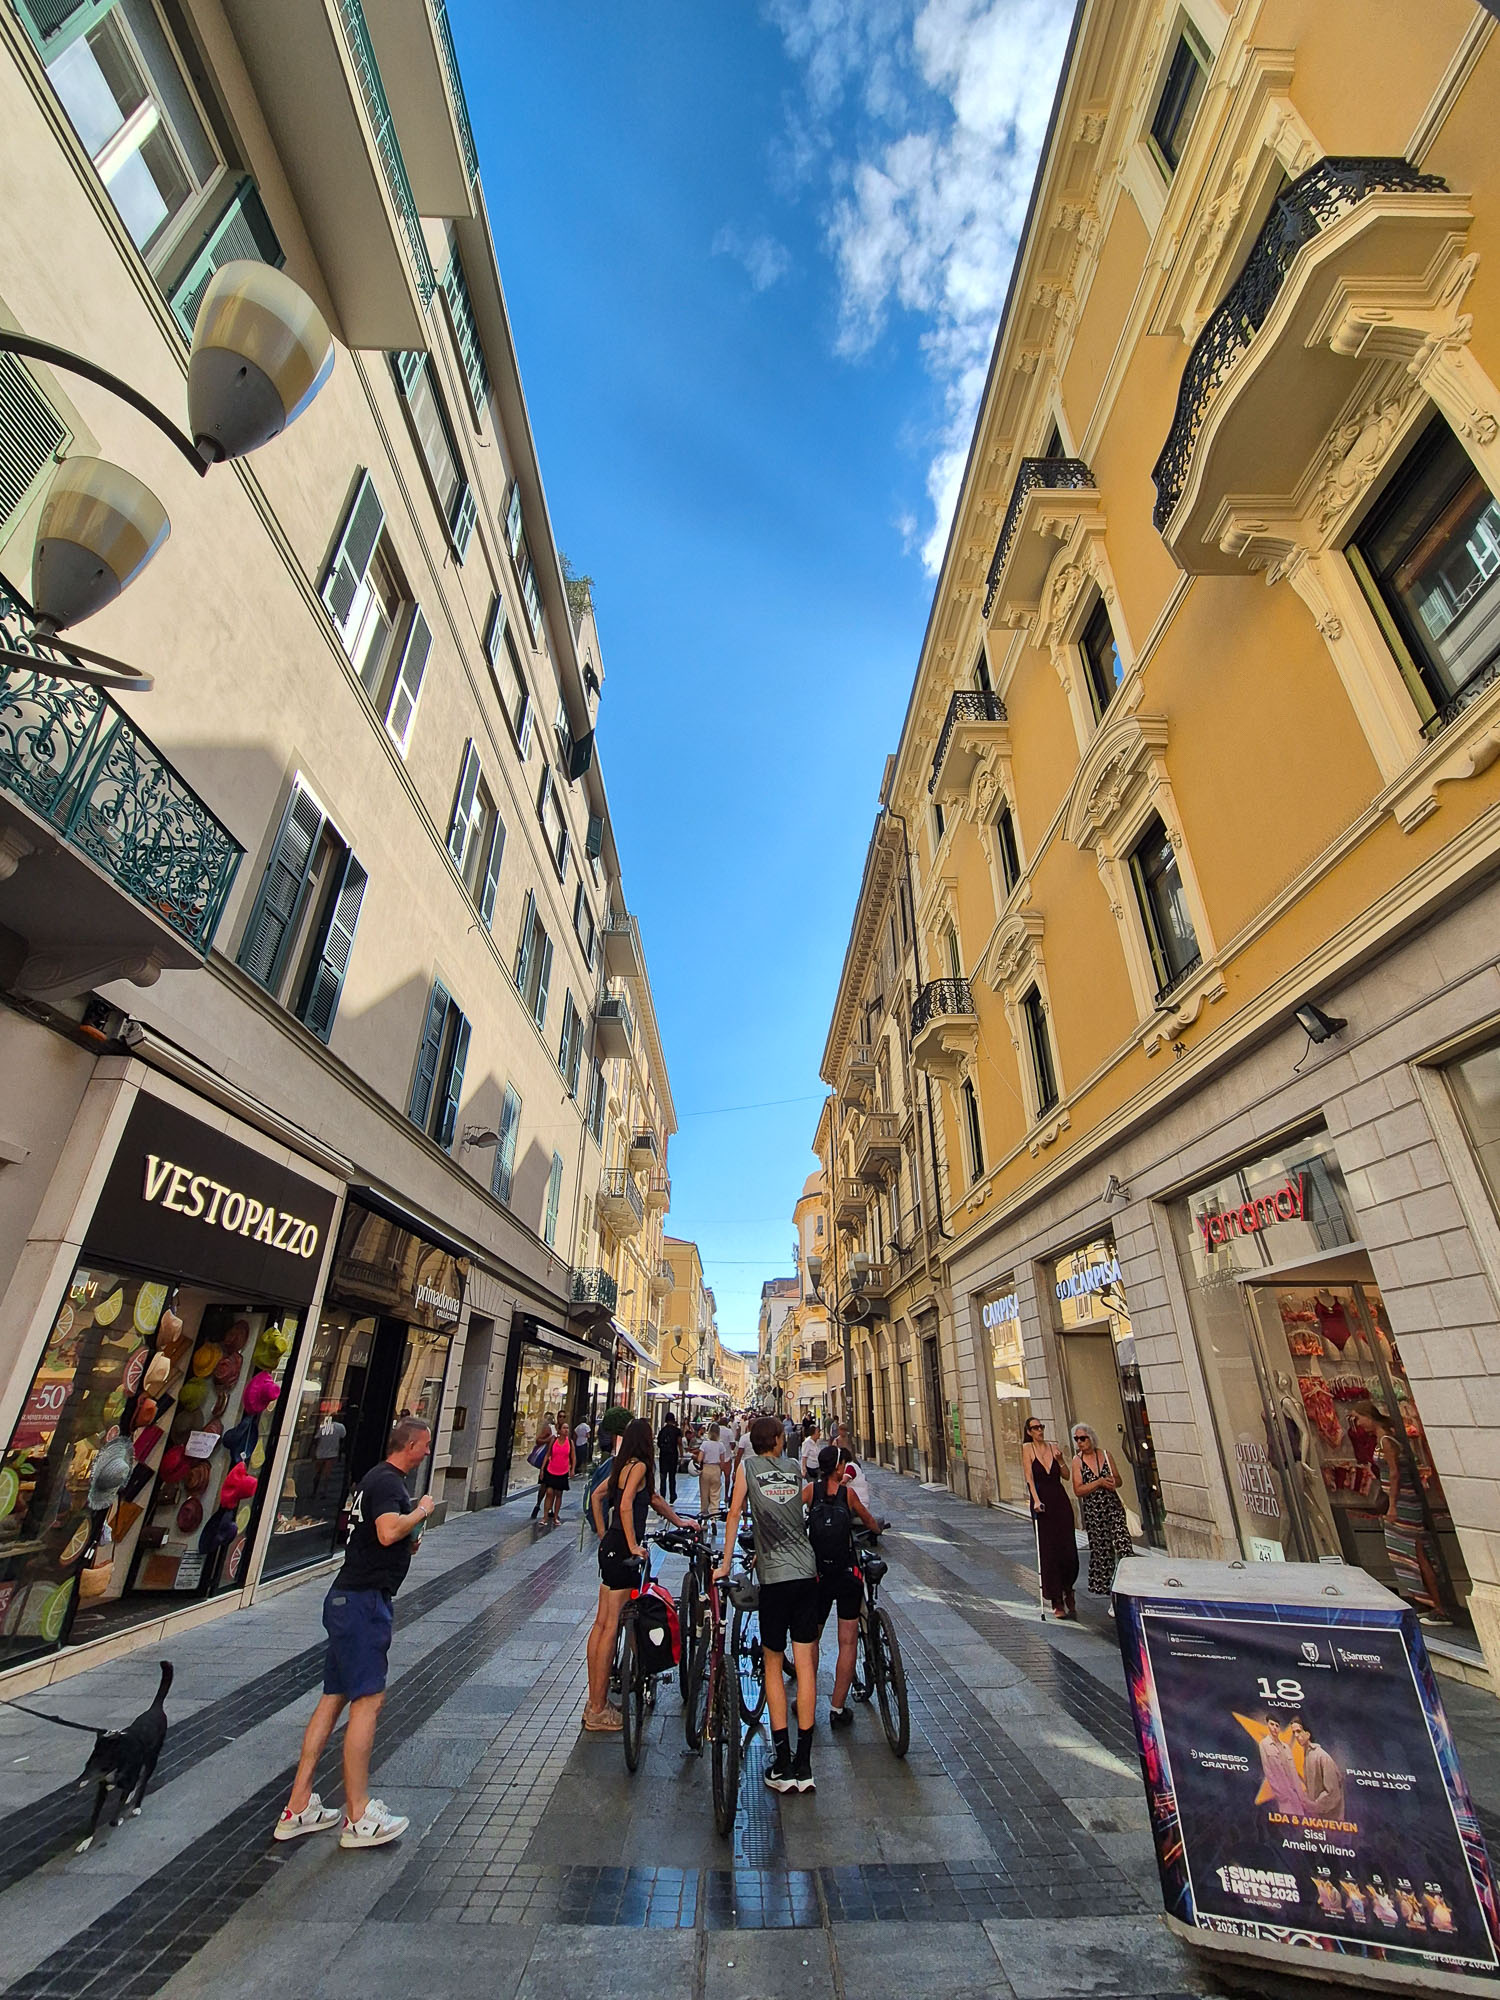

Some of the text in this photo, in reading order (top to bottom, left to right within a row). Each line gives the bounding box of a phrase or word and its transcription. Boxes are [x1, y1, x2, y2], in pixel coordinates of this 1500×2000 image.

[144, 1154, 319, 1259] VESTOPAZZO
[1195, 1172, 1305, 1254] yamamay
[415, 1278, 460, 1313] primadonna
[982, 1292, 1020, 1328] CARPISA
[1241, 1493, 1280, 1518] PREZZO
[1346, 1651, 1381, 1662] Sanremo
[1256, 1677, 1305, 1701] 18
[1267, 1700, 1301, 1709] LUGLIO
[1198, 1751, 1248, 1763] INGRESSO
[1201, 1760, 1249, 1772] GRATUITO
[1346, 1768, 1417, 1783] PIAN DI NAVE
[1356, 1778, 1381, 1788] ORE
[1268, 1812, 1358, 1833] LDA & AKA7EVEN
[1303, 1829, 1327, 1841] Sissi
[1282, 1838, 1356, 1858] Amelie Villano
[1316, 1866, 1331, 1875] 18
[1346, 1870, 1353, 1879] 1
[1228, 1865, 1298, 1890] SUMMER
[1372, 1874, 1383, 1883] 8
[1397, 1877, 1412, 1887] 15
[1424, 1881, 1442, 1893] 22
[1271, 1886, 1301, 1903] 2026
[1243, 1897, 1282, 1909] SANREMO
[1215, 1921, 1239, 1935] 2026
